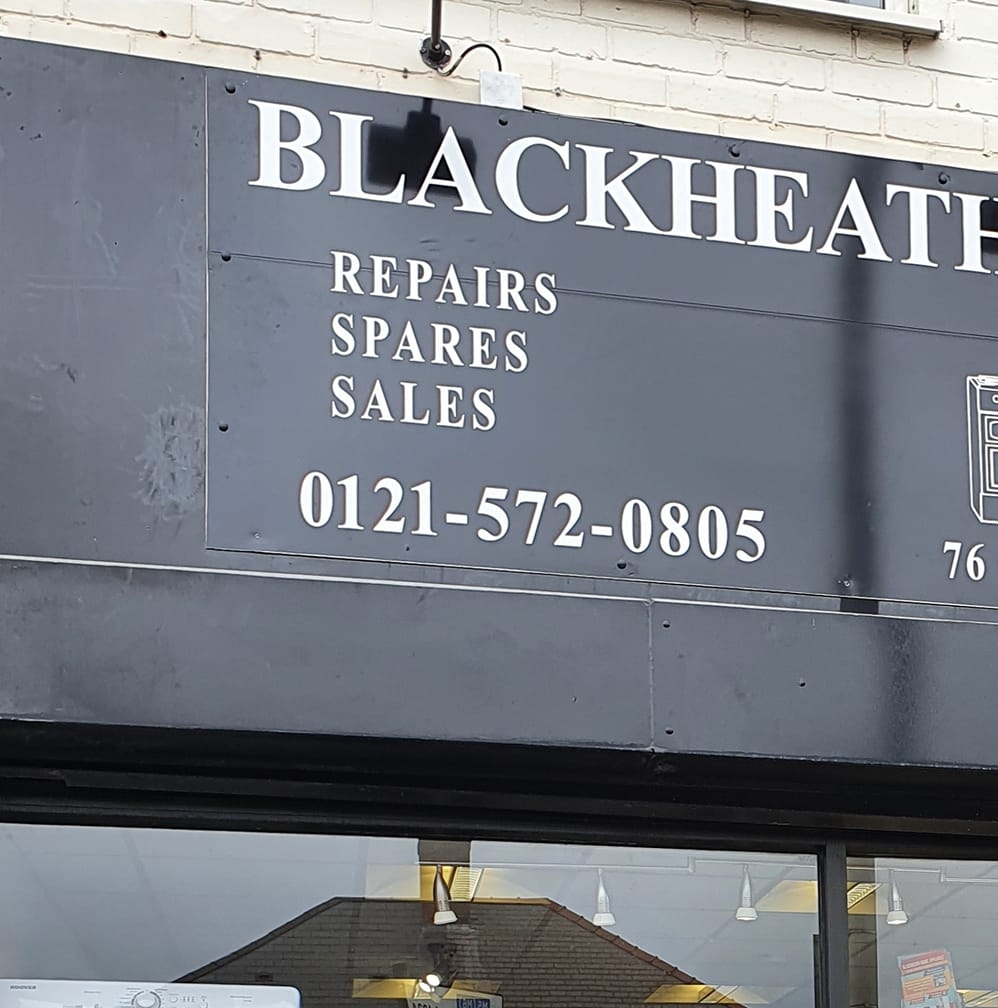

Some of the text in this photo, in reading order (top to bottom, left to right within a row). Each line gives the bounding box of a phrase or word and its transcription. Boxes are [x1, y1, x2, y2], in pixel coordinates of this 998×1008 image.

[330, 250, 559, 315] REPAIRS
[330, 313, 529, 373] SPARES
[330, 375, 497, 432] SALES
[299, 470, 767, 563] 0121-572-0805
[942, 541, 986, 581] 76
